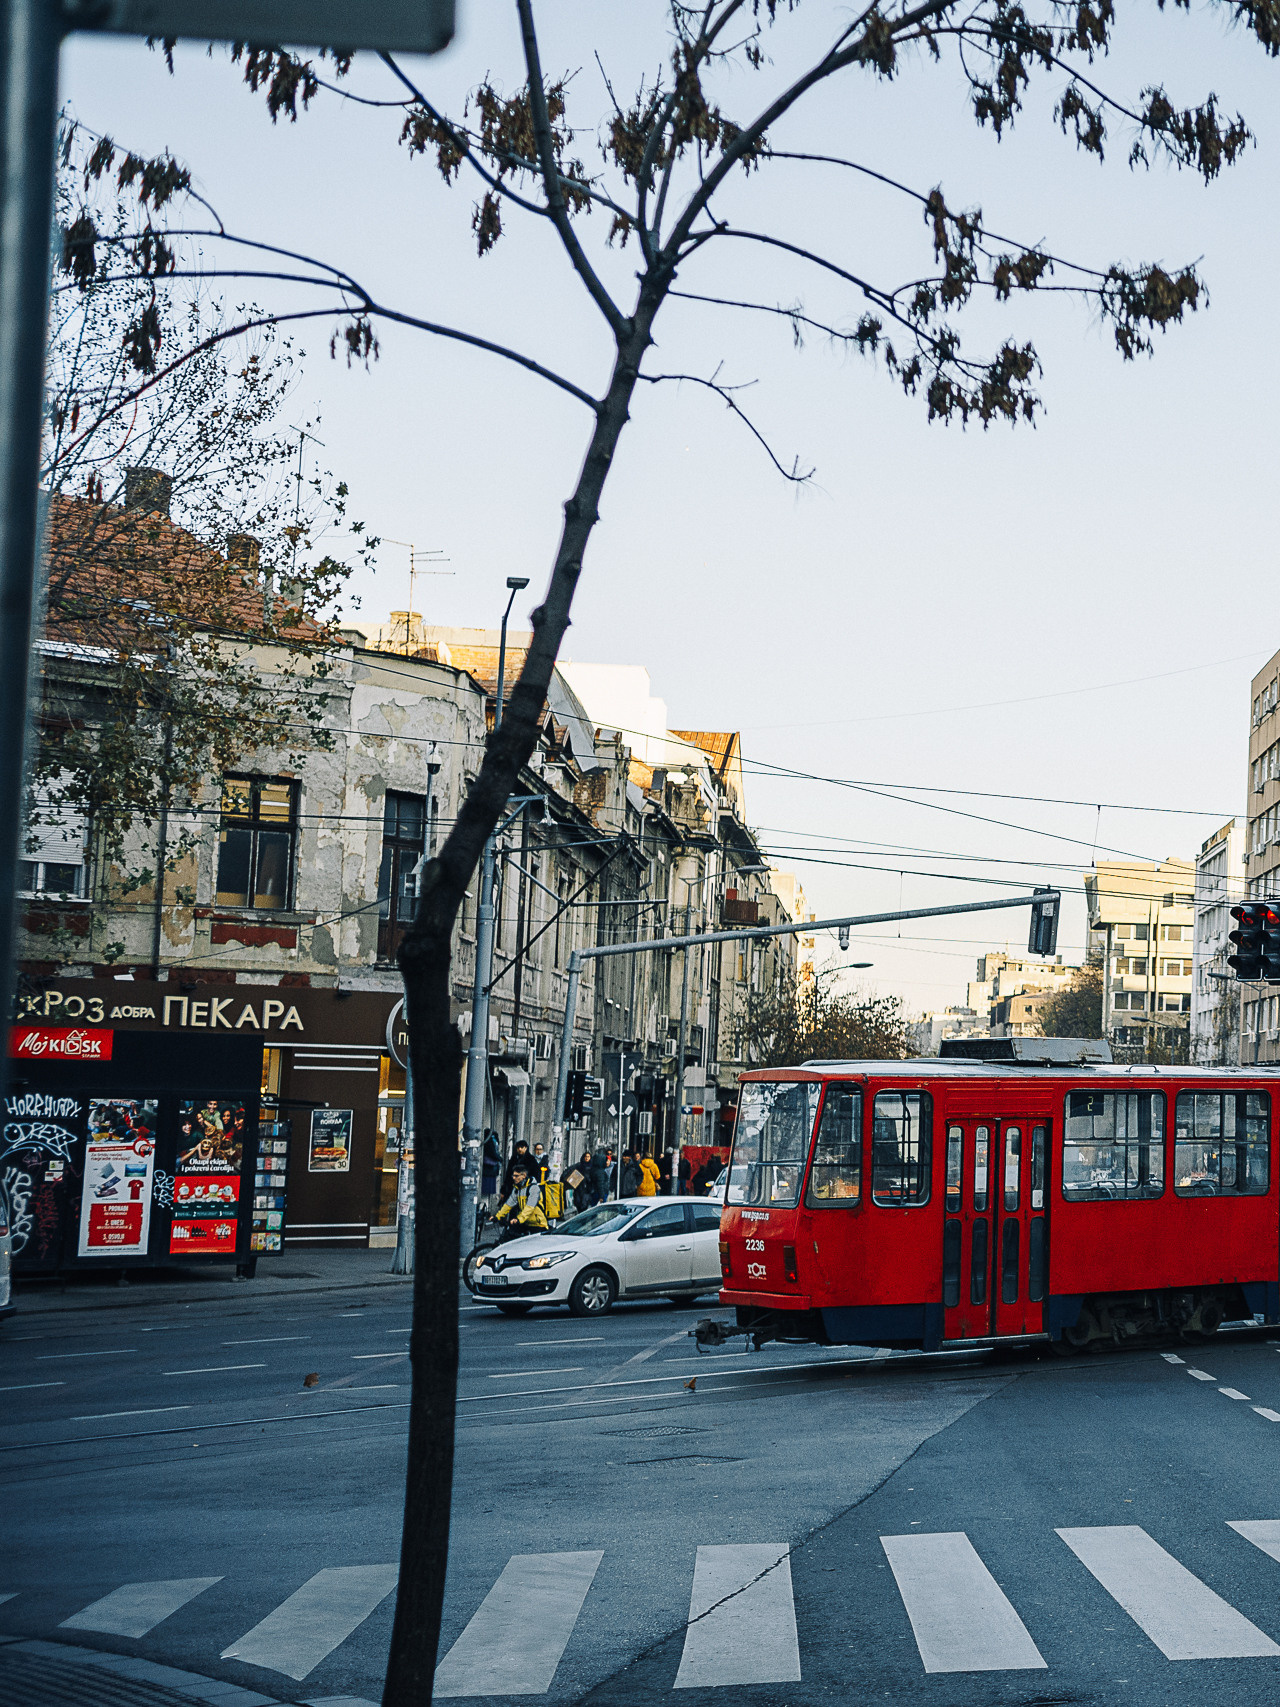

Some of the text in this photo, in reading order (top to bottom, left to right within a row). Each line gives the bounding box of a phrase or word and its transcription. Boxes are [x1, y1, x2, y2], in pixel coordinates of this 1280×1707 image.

[110, 1005, 155, 1019] ДОБРА
[163, 995, 304, 1031] ПЕКАРА
[1087, 1095, 1094, 1112] 2
[746, 1239, 765, 1251] 2236
